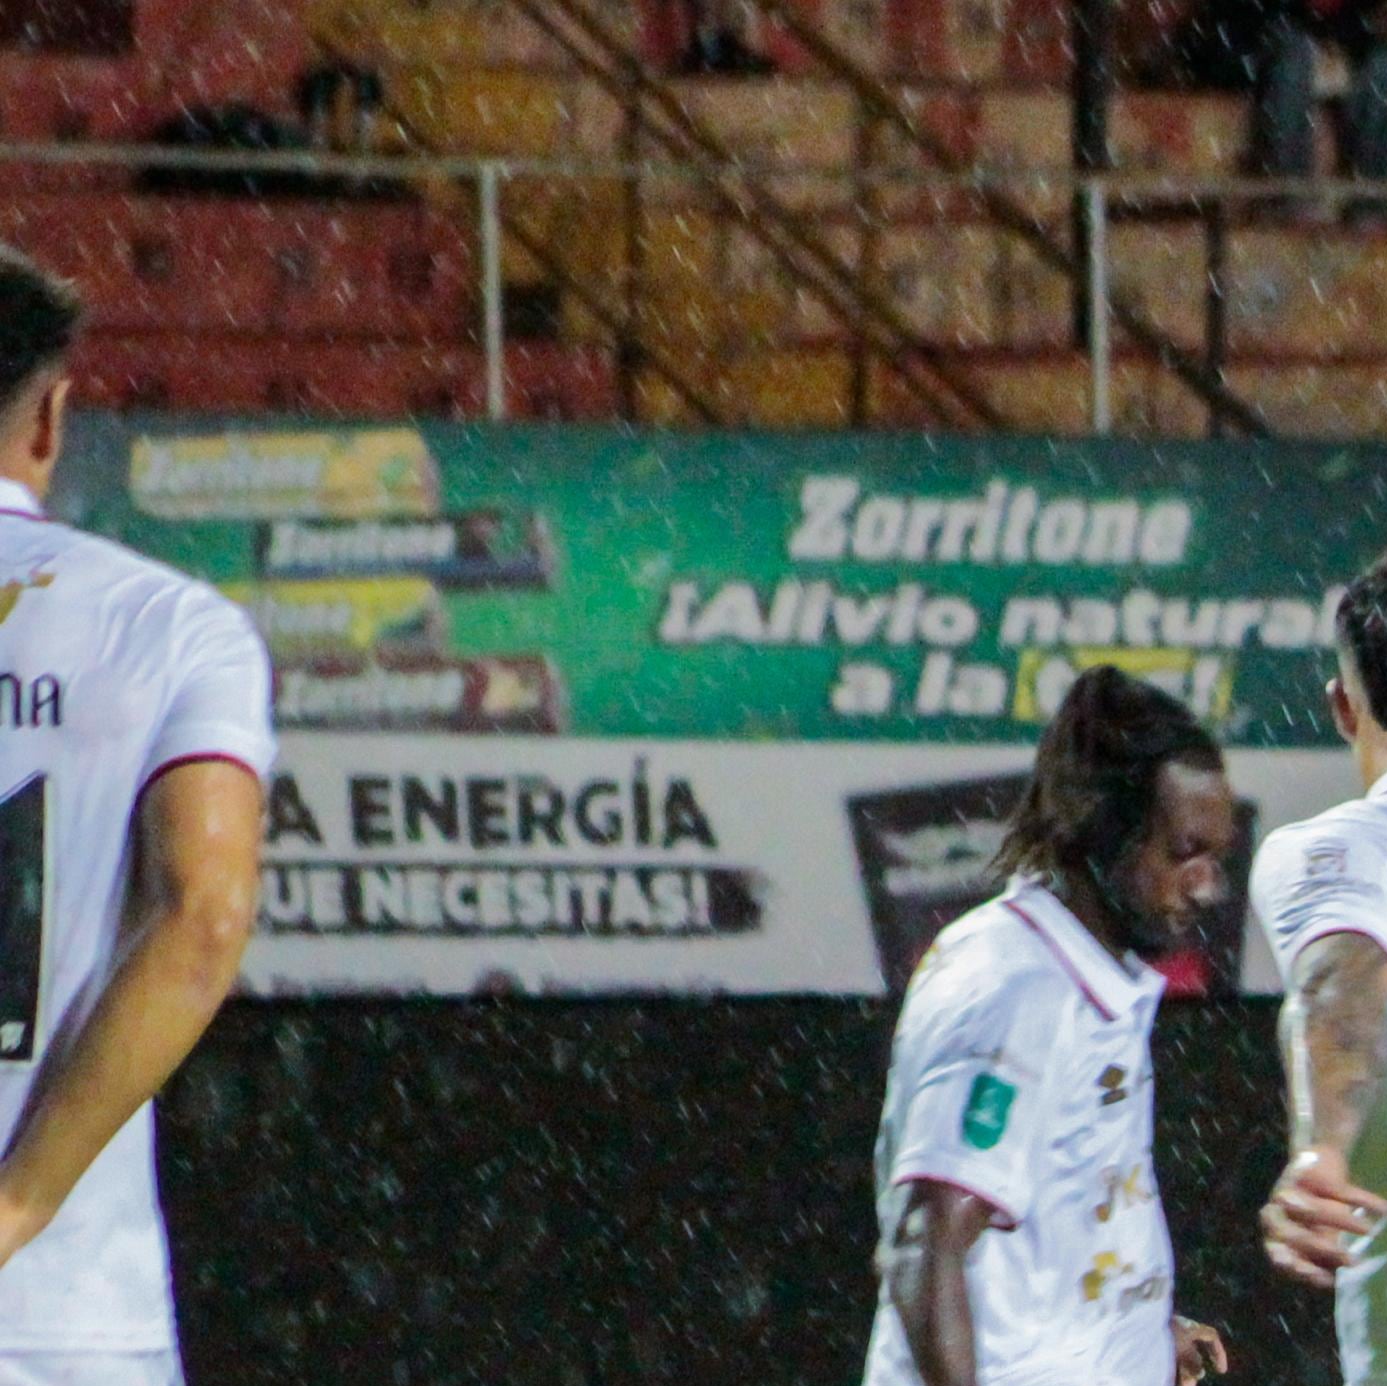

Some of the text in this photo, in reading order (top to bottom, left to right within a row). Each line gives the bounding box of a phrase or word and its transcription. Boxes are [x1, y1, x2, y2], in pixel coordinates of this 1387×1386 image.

[788, 473, 1192, 565] Zorritone
[1001, 587, 1350, 646] natural
[830, 660, 893, 716] a
[913, 652, 1008, 717] la
[266, 752, 721, 851] A ENERGÍA
[263, 866, 343, 926] UE
